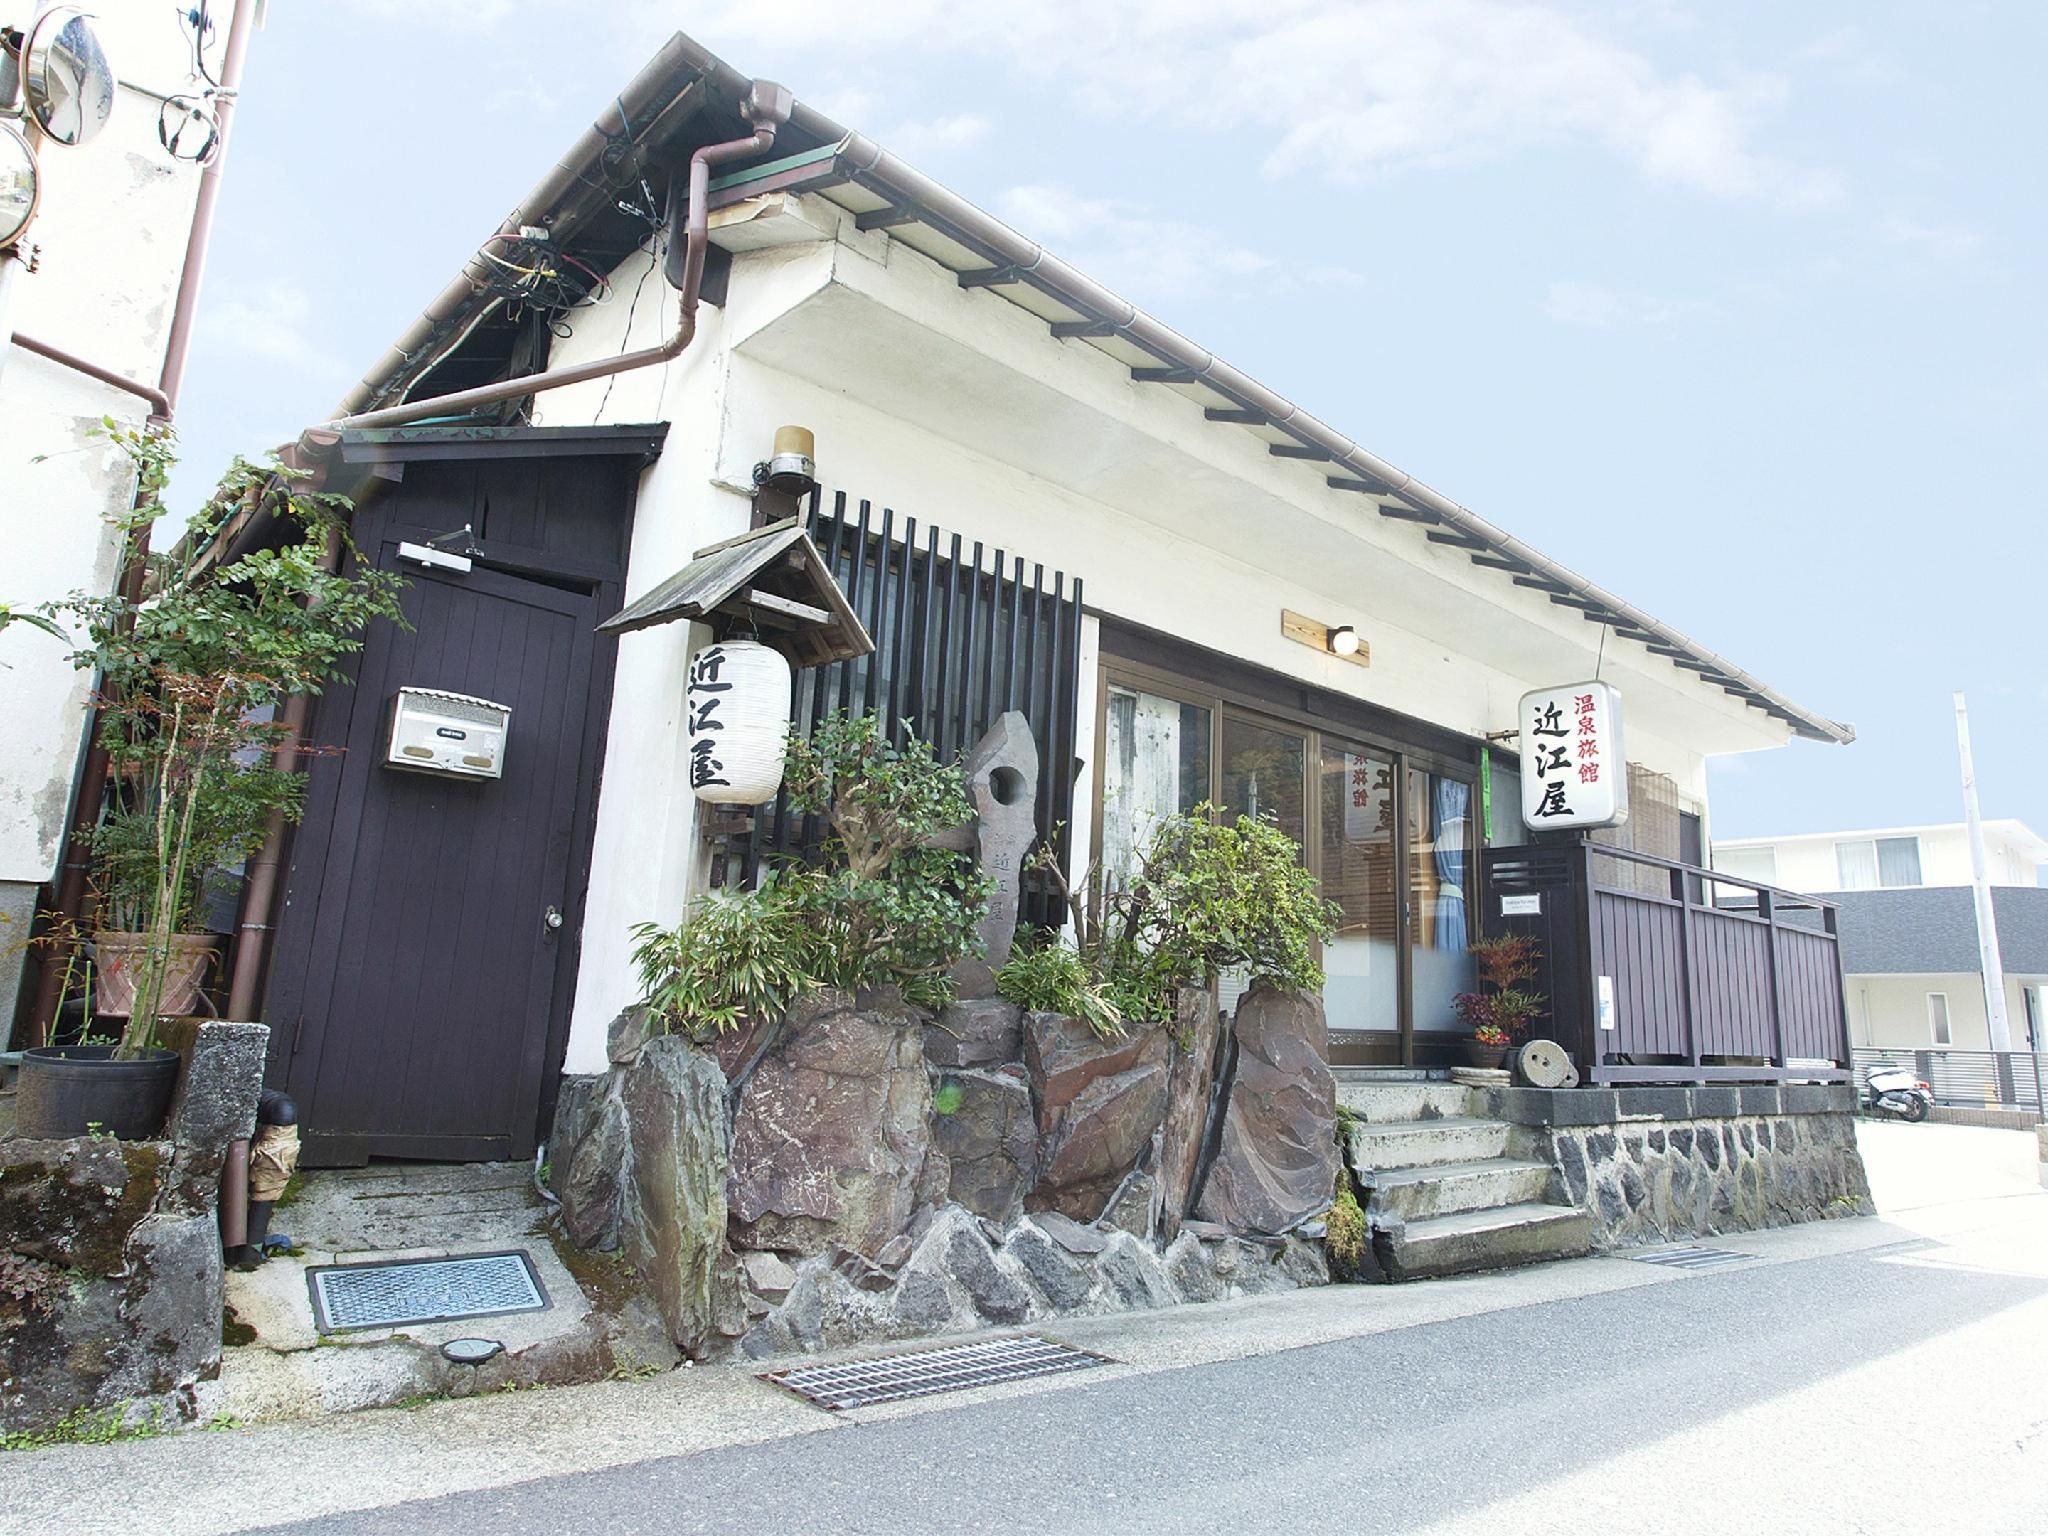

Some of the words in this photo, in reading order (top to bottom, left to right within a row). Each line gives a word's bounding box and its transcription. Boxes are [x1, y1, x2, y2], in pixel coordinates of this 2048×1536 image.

[687, 647, 733, 790] 近江屋
[1532, 701, 1575, 818] 近江屋
[1575, 694, 1601, 784] 温泉旅館
